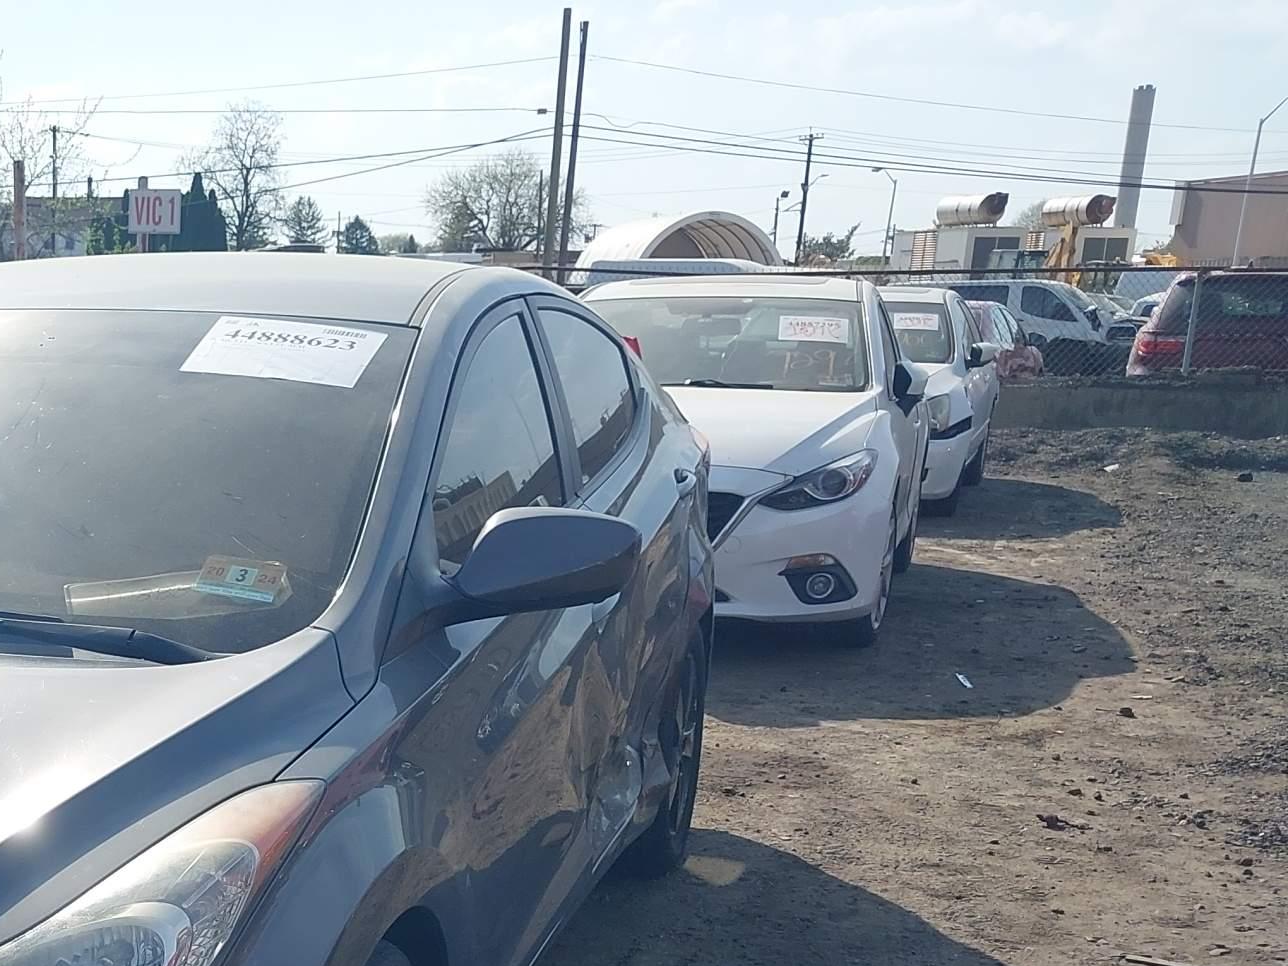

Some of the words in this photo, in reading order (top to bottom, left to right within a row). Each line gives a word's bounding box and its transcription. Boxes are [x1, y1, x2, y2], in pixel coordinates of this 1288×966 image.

[135, 196, 162, 226] VIC
[168, 196, 175, 226] 1
[225, 328, 357, 351] 44888623
[207, 566, 225, 577] 20
[235, 568, 249, 582] 3
[258, 574, 277, 585] 24
